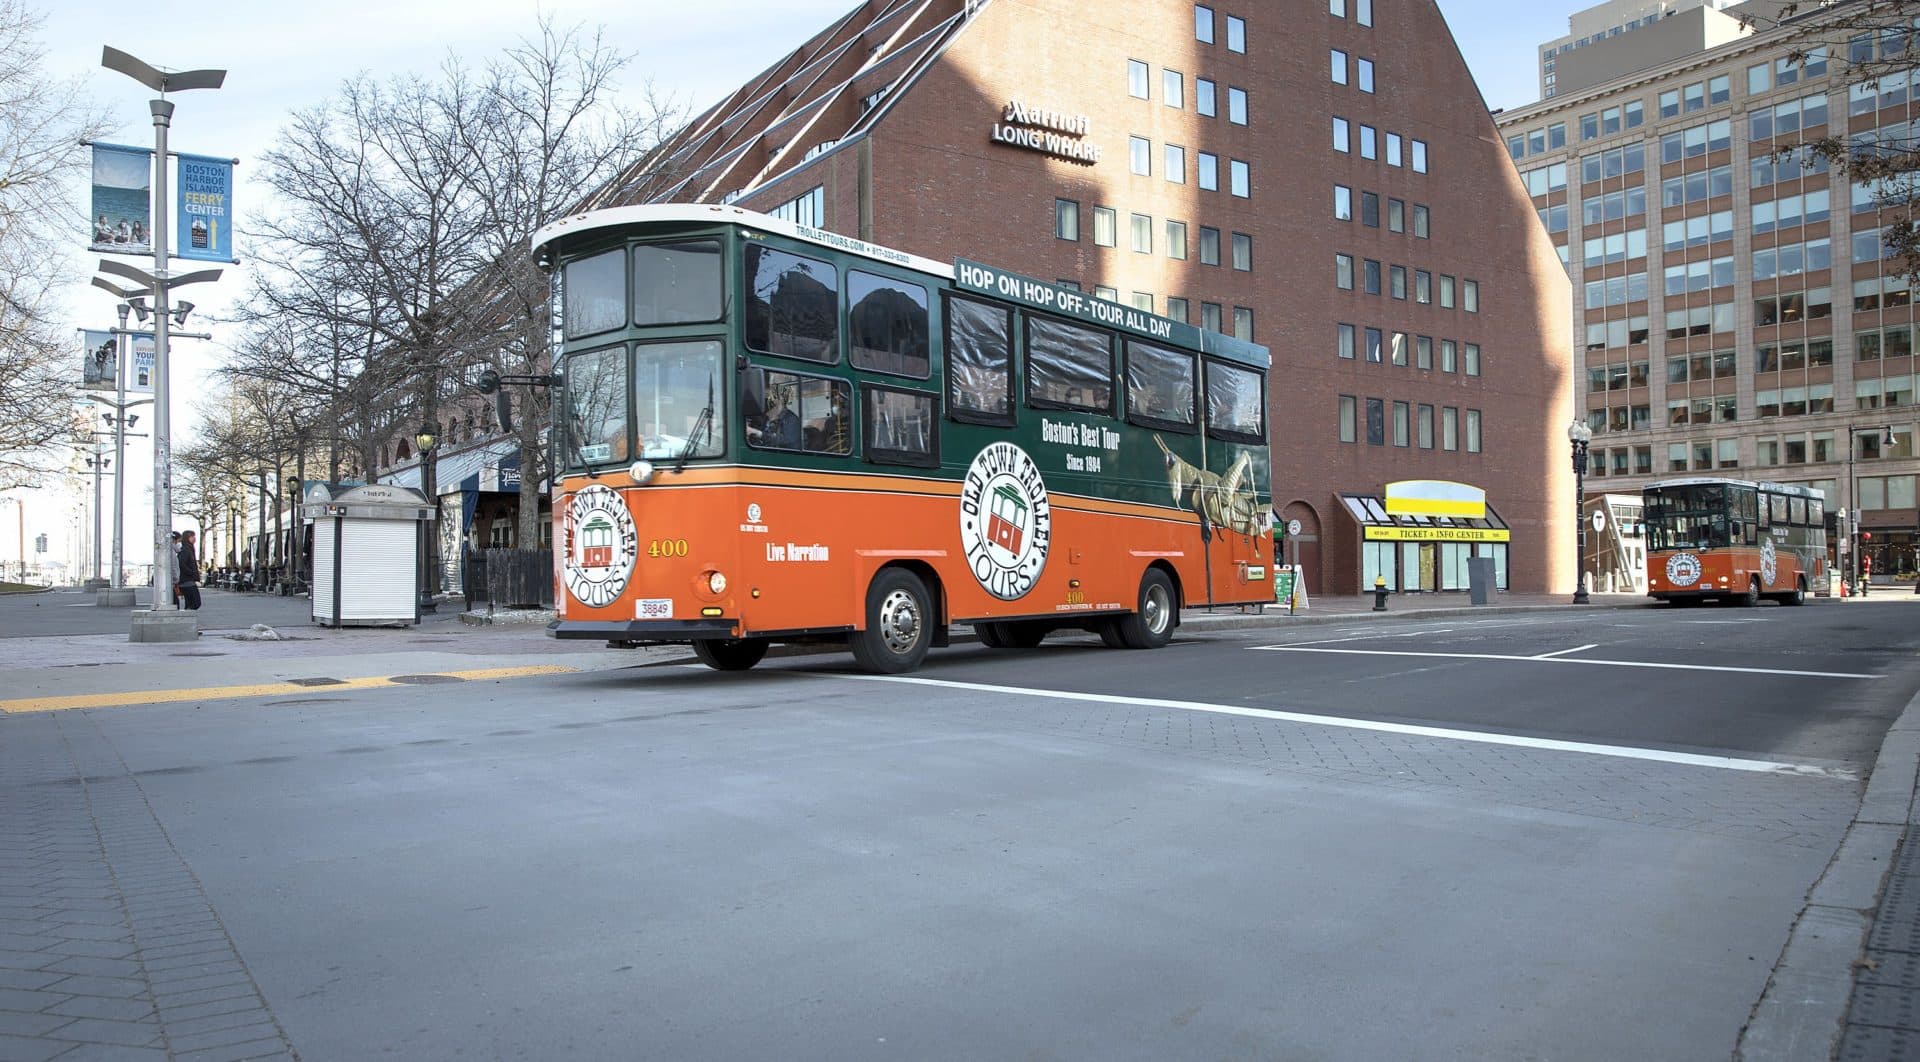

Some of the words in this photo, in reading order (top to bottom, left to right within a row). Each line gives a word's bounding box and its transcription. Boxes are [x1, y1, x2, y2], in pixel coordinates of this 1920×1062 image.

[993, 123, 1040, 149] LONG
[1045, 132, 1103, 160] WHARF
[186, 164, 224, 177] BOSTON
[186, 174, 224, 186] HARBOR
[186, 183, 224, 195] ISLANDS
[185, 192, 224, 206] FERRY
[185, 203, 224, 216] CENTER
[796, 225, 865, 253] TROLLEYTOURS.COM
[960, 263, 994, 290] HOP
[998, 275, 1020, 298] ON
[1024, 281, 1054, 306] HOP
[1126, 316, 1147, 332] ALL
[1150, 322, 1171, 339] DAY
[1042, 418, 1079, 446] Boston's
[1081, 423, 1100, 448] Best
[1102, 427, 1120, 450] Tour
[1066, 453, 1084, 471] Since
[962, 471, 984, 517] OLD
[978, 445, 1017, 479] TOWN
[1019, 456, 1050, 558] TROLLEY
[1596, 515, 1603, 527] T
[1400, 530, 1427, 538] TICKET
[1456, 531, 1485, 539] CENTER
[647, 539, 689, 557] 400
[766, 542, 785, 562] Live
[787, 542, 829, 562] Narration
[968, 533, 1032, 597] TOURS
[569, 568, 626, 606] TOURS
[1066, 591, 1084, 604] 400
[641, 603, 669, 614] 38849
